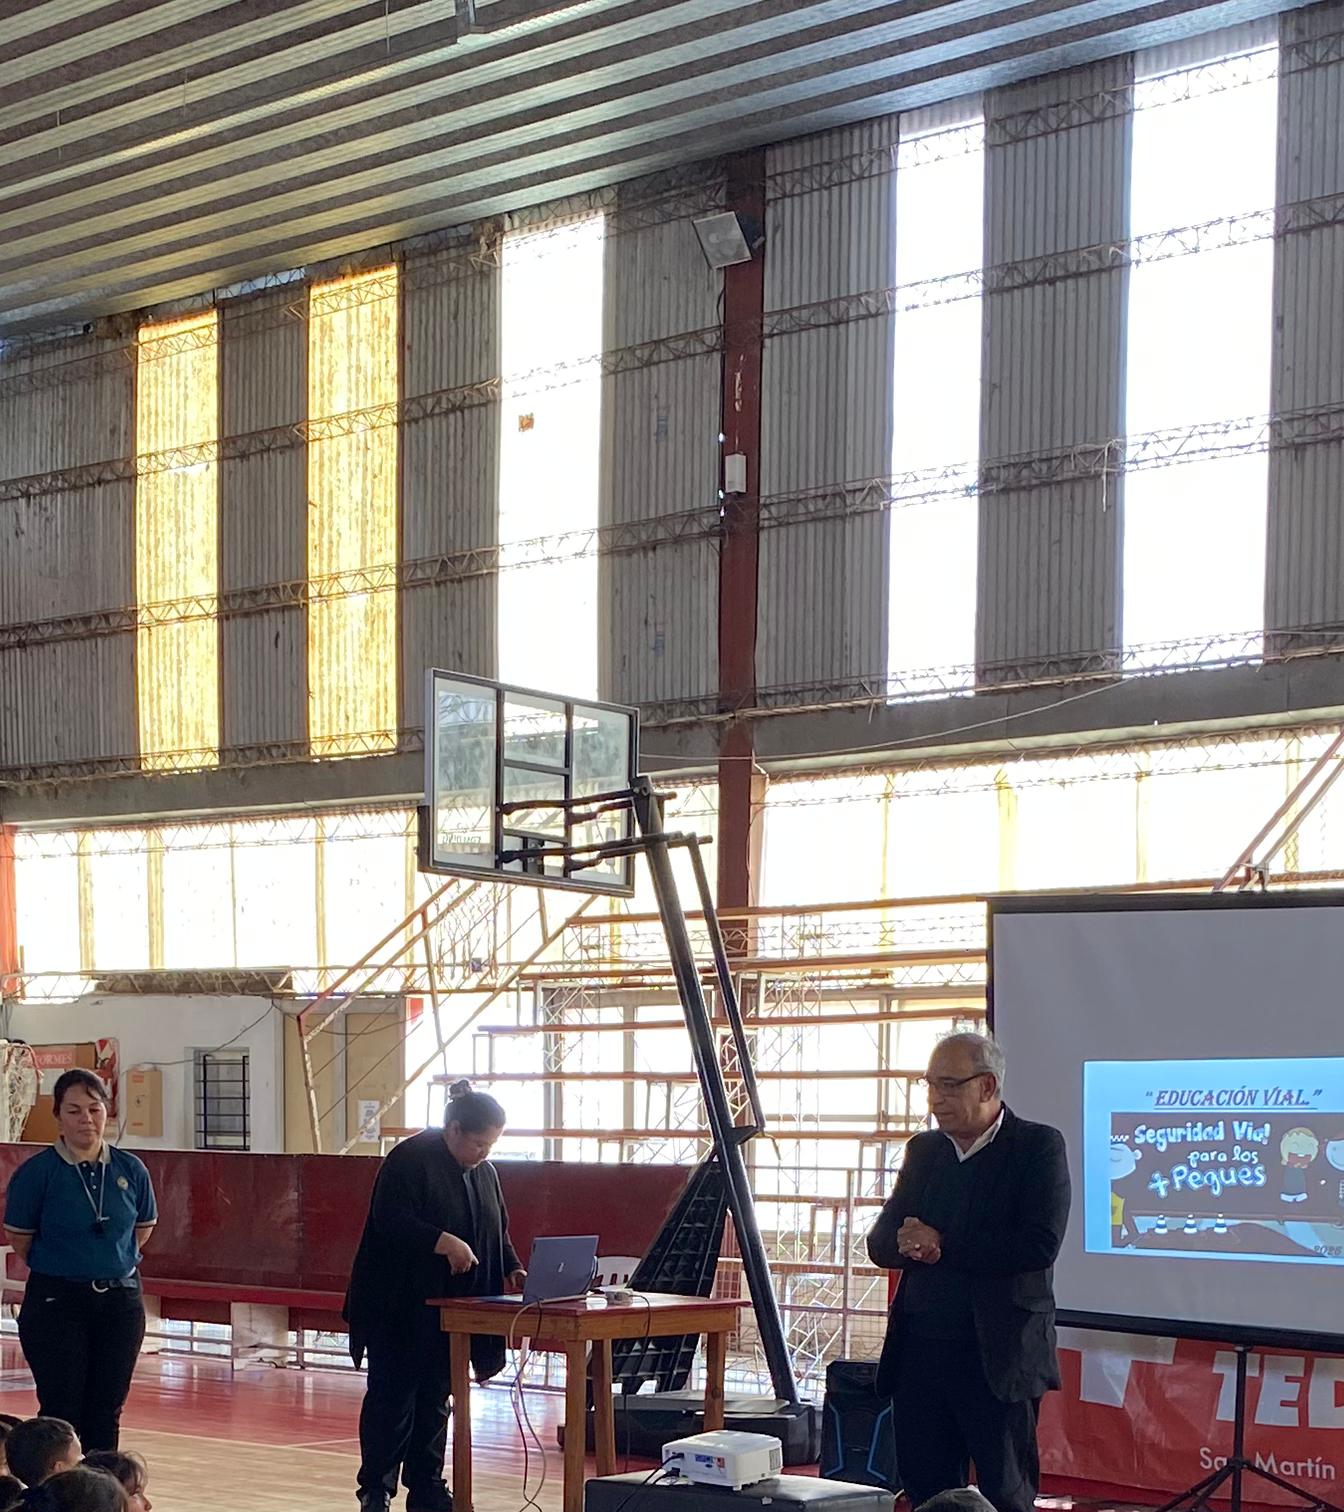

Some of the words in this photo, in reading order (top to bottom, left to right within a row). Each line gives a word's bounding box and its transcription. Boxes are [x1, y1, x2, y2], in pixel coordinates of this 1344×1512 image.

[1134, 1120, 1225, 1153] Seguridad
[1187, 1149, 1228, 1168] para
[1231, 1145, 1259, 1165] los
[1170, 1163, 1268, 1198] Peques
[1255, 1451, 1336, 1480] Martín
